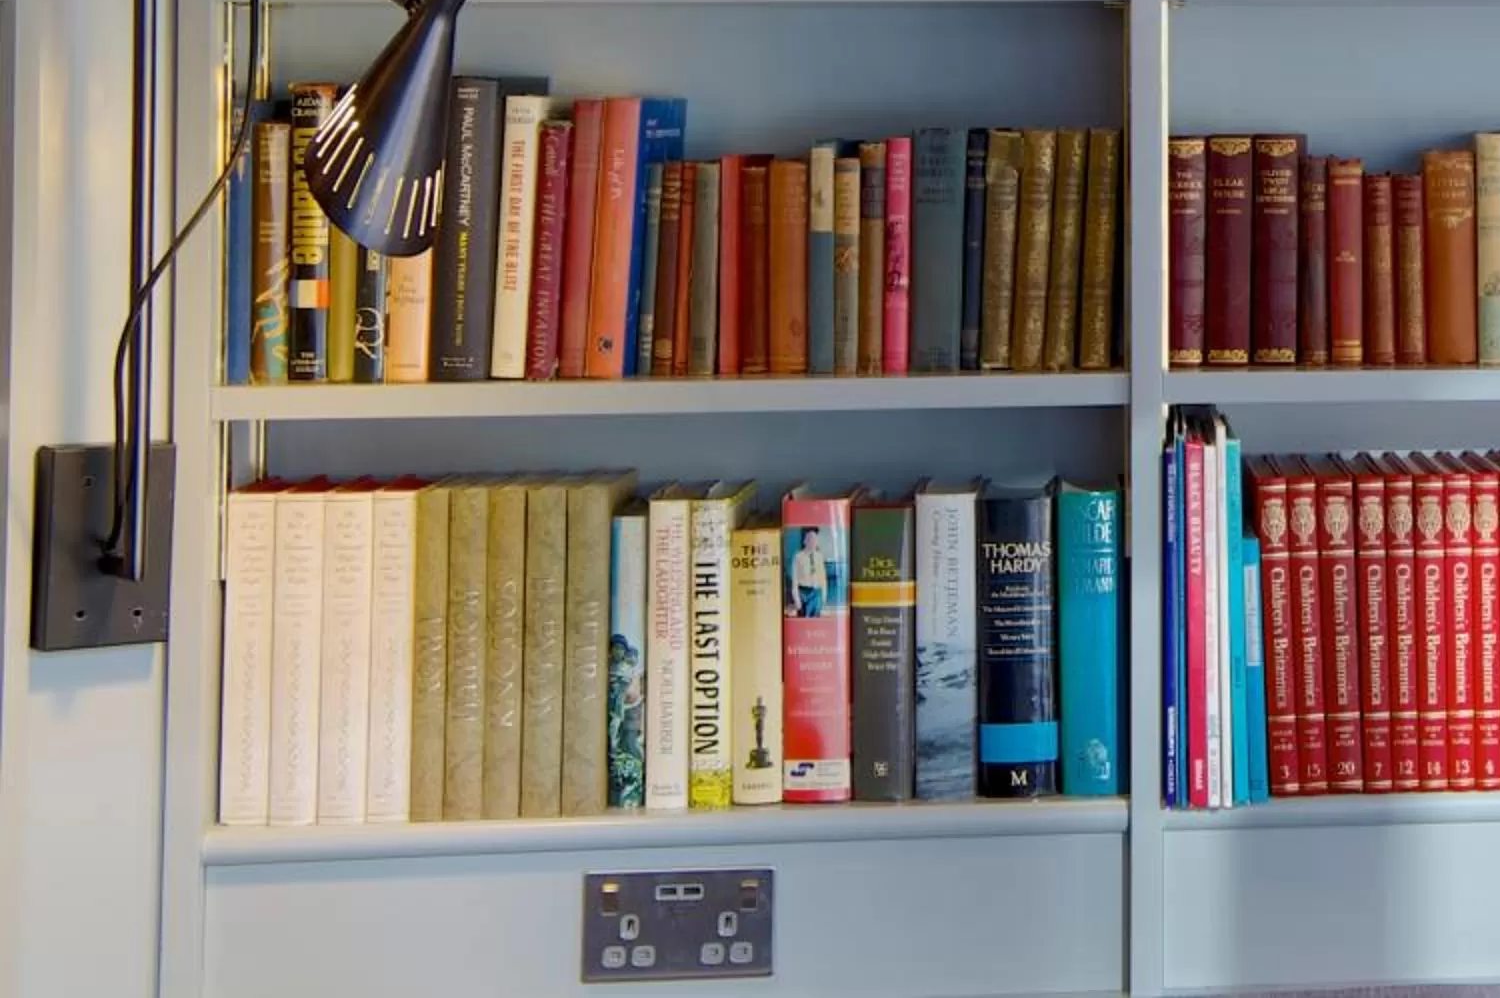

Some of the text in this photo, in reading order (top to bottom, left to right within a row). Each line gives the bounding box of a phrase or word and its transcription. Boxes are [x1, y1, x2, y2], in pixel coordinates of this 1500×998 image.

[461, 107, 475, 141] PAUL
[511, 140, 526, 159] THE
[458, 143, 474, 227] McCARTNEY
[532, 288, 554, 372] INVASION
[742, 546, 769, 556] THE
[982, 544, 1052, 559] THOMAS
[1190, 462, 1201, 576] BLACK BEAUTY
[732, 558, 780, 569] OSCAR
[991, 559, 1043, 574] HARDY
[694, 562, 720, 755] THE LAST OPTION
[1271, 567, 1288, 708] Children's Britannica
[1299, 565, 1317, 707] Children's Britannica
[1333, 564, 1350, 705] Children's Britannica
[1367, 564, 1384, 705] Children's Britannica
[1396, 564, 1413, 704] Children's Britannica
[1425, 564, 1441, 704] Children's Britannica
[1453, 562, 1470, 703] Children's Britannica
[1481, 562, 1497, 703] Children's Britannica
[1011, 770, 1028, 786] M
[1337, 761, 1355, 775] 20
[1399, 760, 1414, 774] 12
